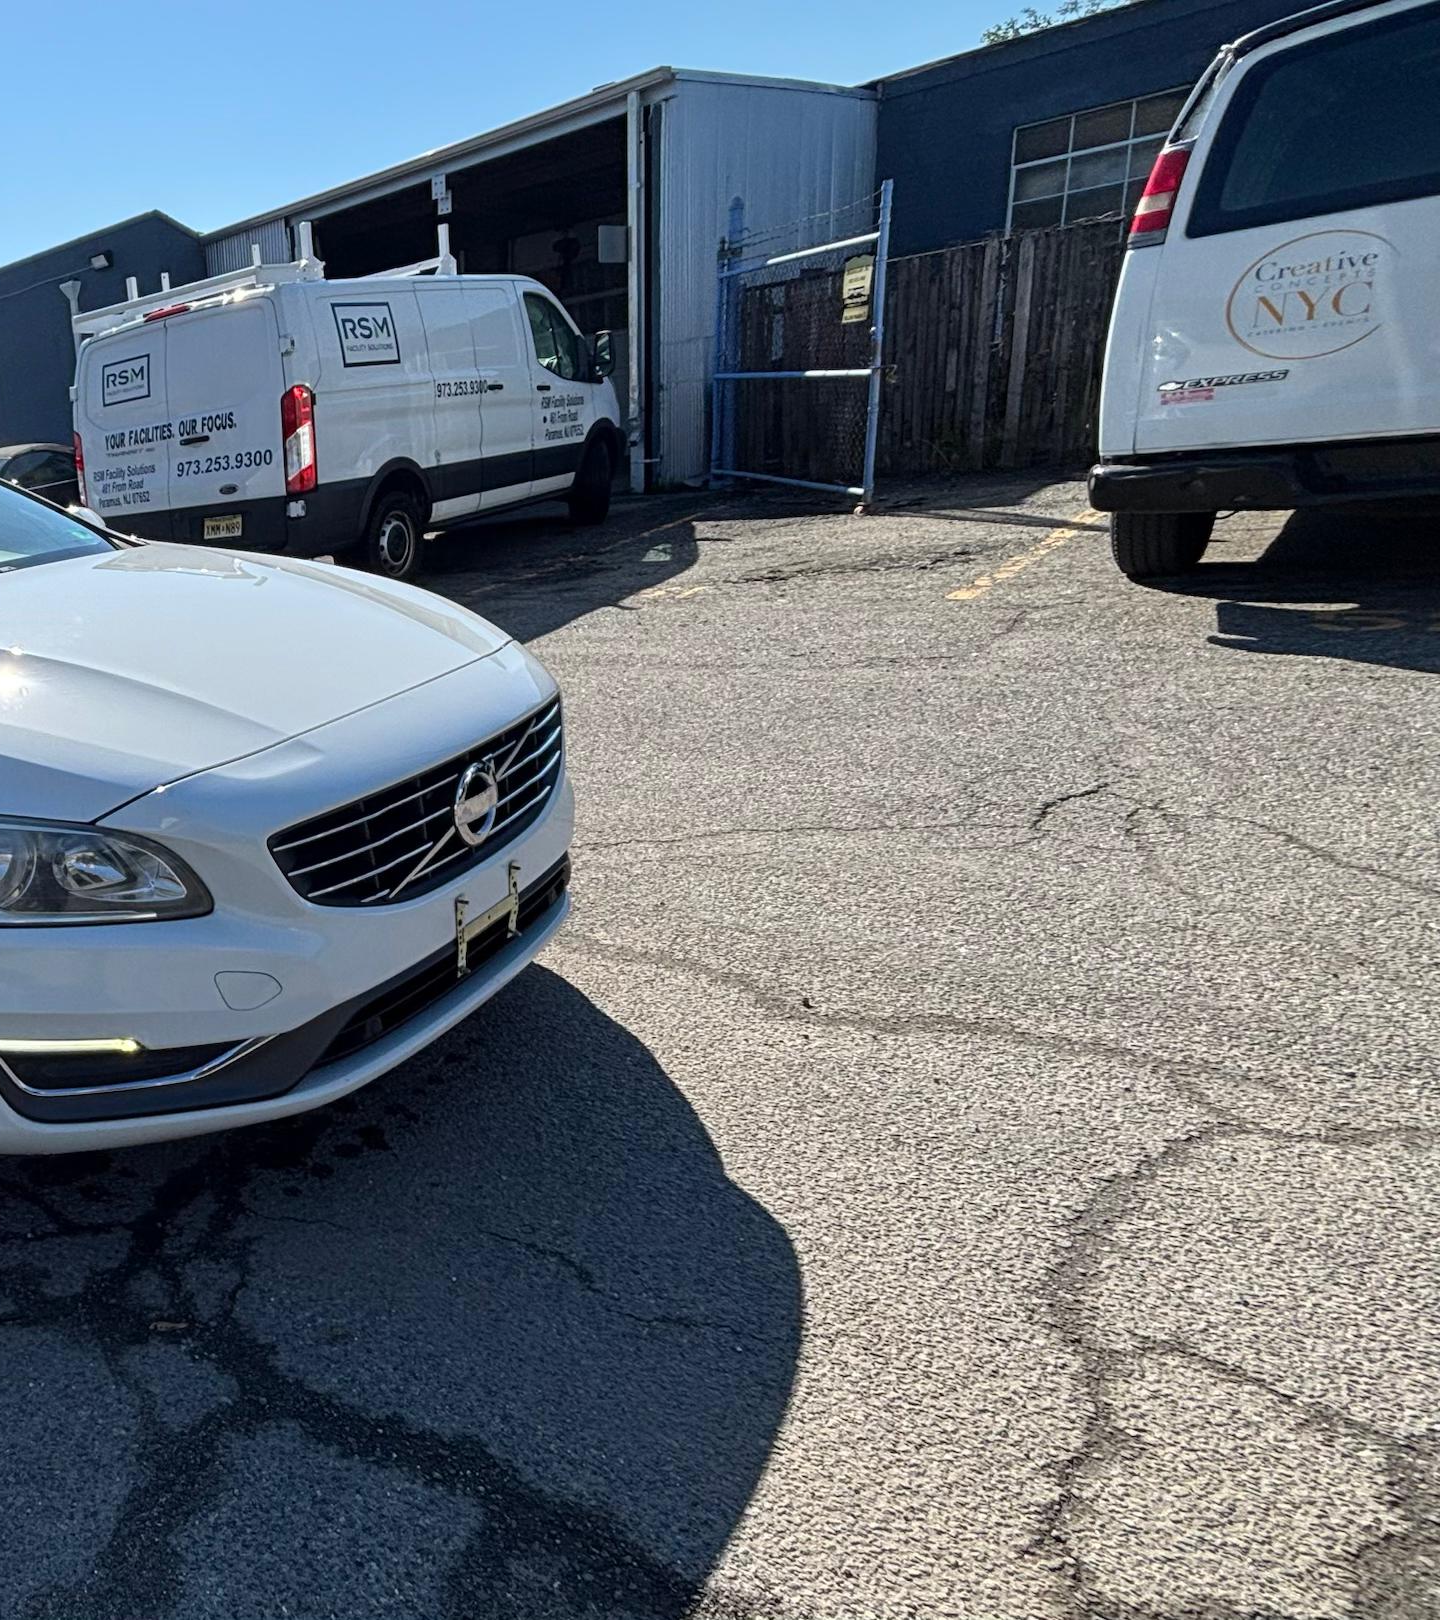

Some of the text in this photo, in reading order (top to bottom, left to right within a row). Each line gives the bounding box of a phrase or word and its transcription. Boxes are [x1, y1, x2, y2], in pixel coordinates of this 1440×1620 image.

[1254, 250, 1379, 282] Creative
[1254, 268, 1376, 294] CONCEPTS
[1252, 280, 1373, 328] NYC
[340, 316, 392, 340] RSM
[105, 365, 145, 389] RSM
[436, 379, 488, 398] 973.253.9300
[1183, 370, 1288, 389] EXPRESS
[104, 412, 237, 451] YOUR FACILITIES. OUR FOCUS.
[176, 449, 273, 478] 973.253.9300
